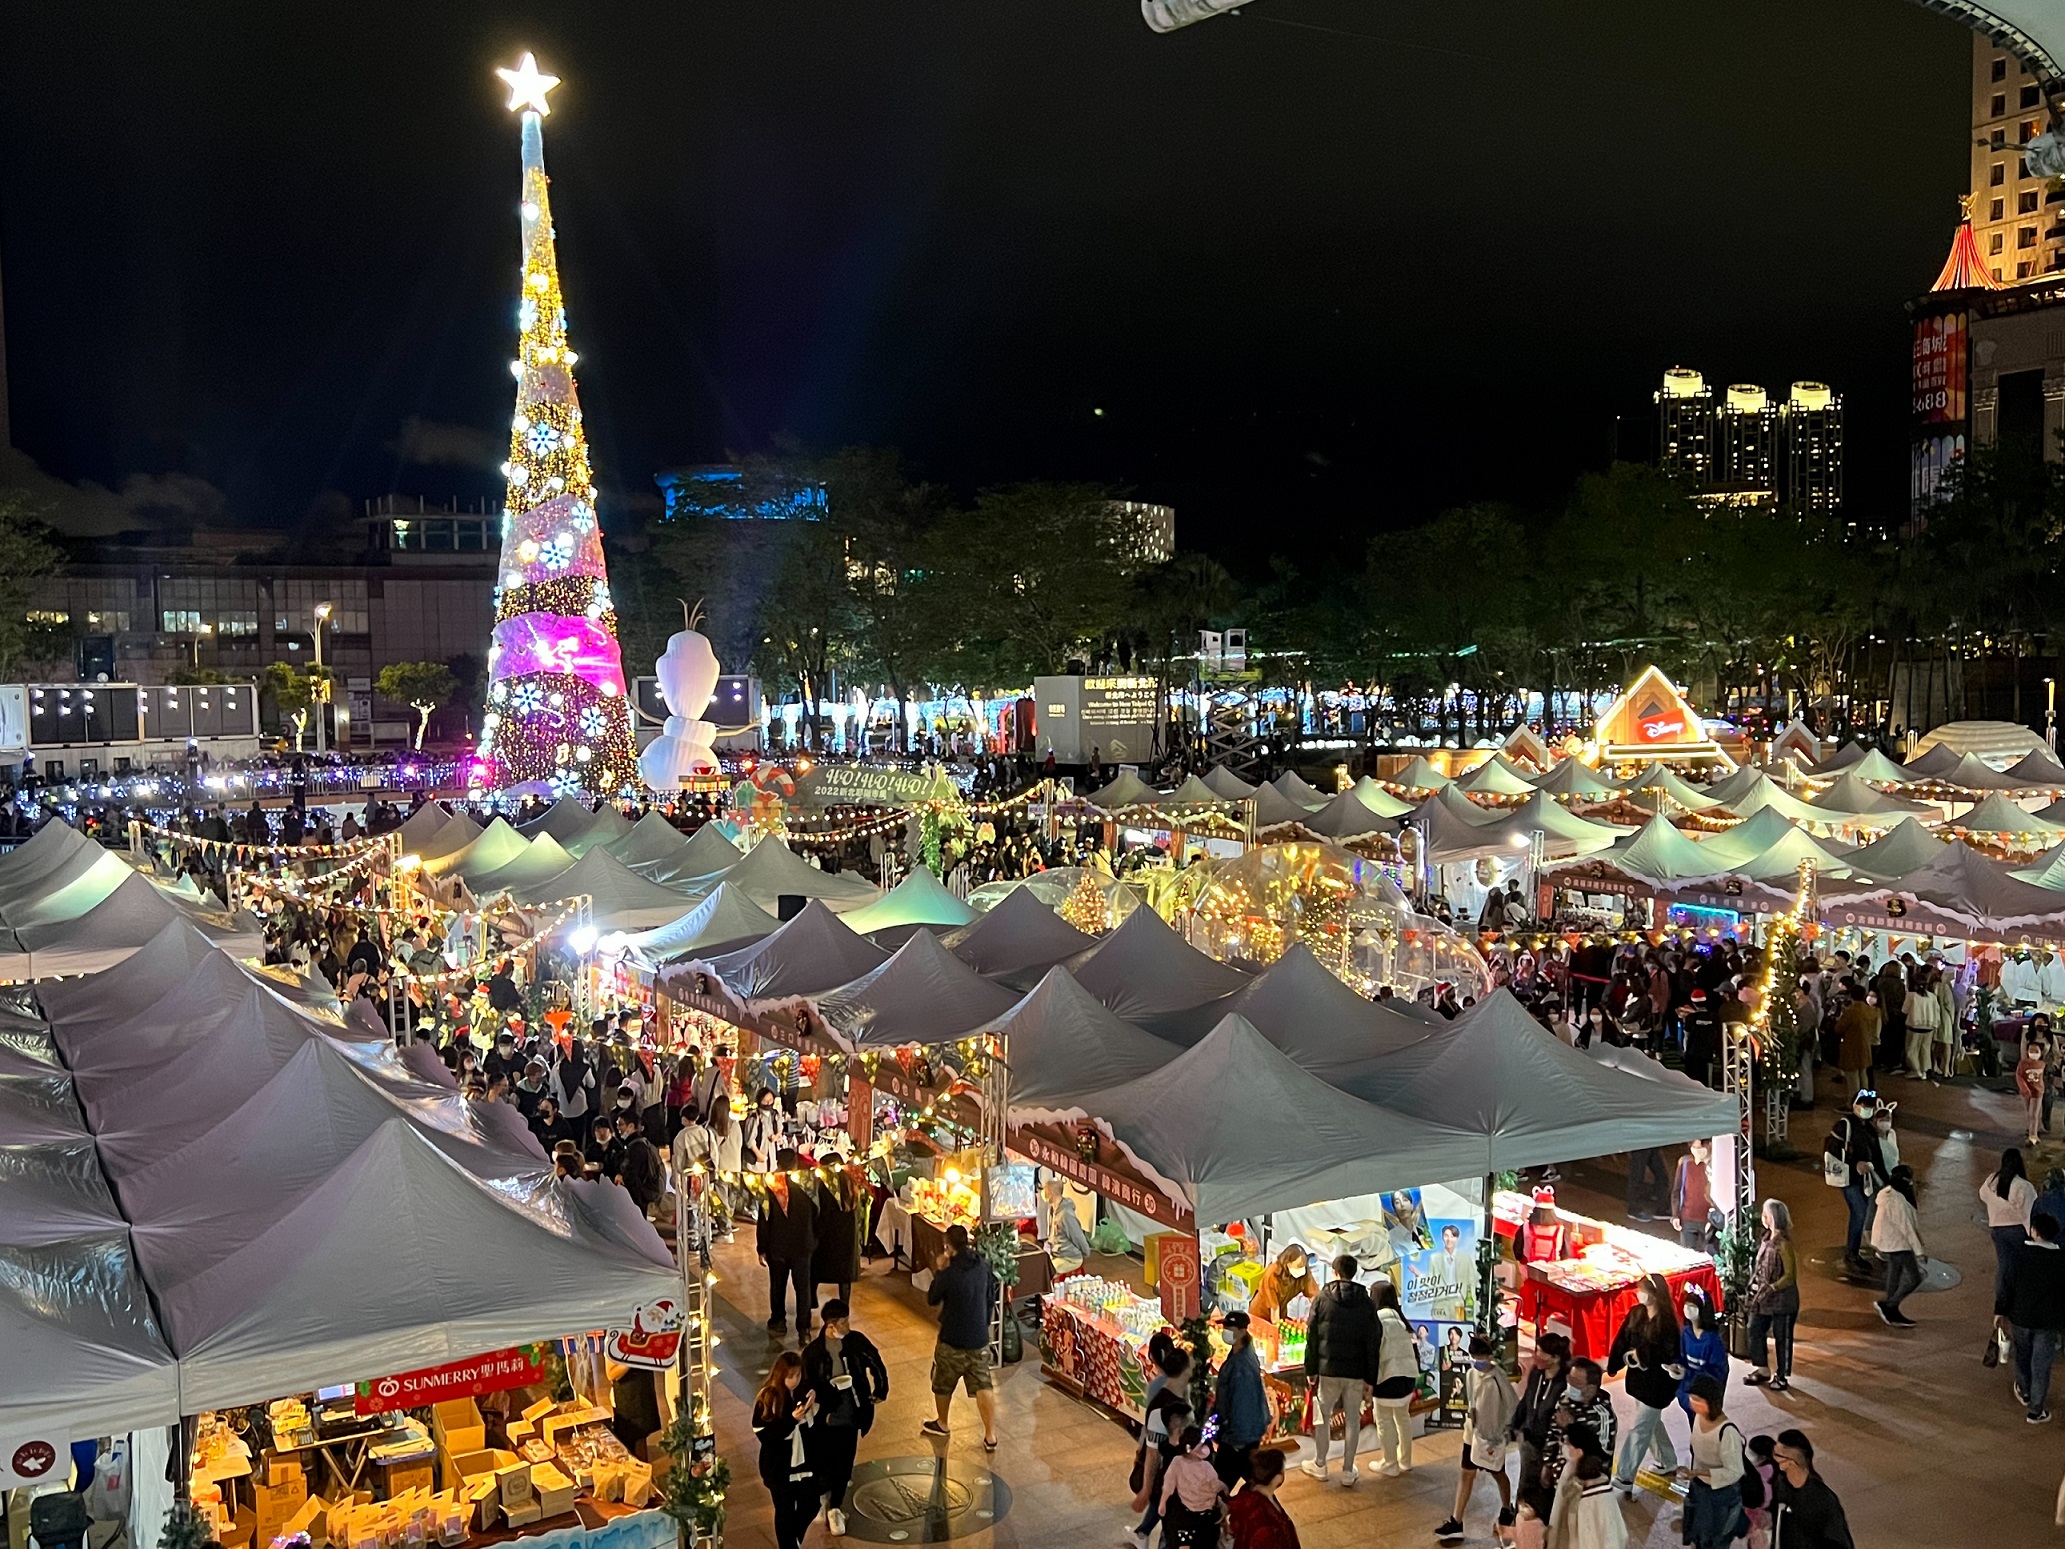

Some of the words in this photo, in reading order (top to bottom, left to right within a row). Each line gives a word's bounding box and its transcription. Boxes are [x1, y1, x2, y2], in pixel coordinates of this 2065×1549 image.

[1642, 720, 1684, 738] Disney
[1407, 1278, 1418, 1290] 이
[403, 1367, 480, 1392] SUNMERRY
[481, 1357, 524, 1378] 聖瑪莉
